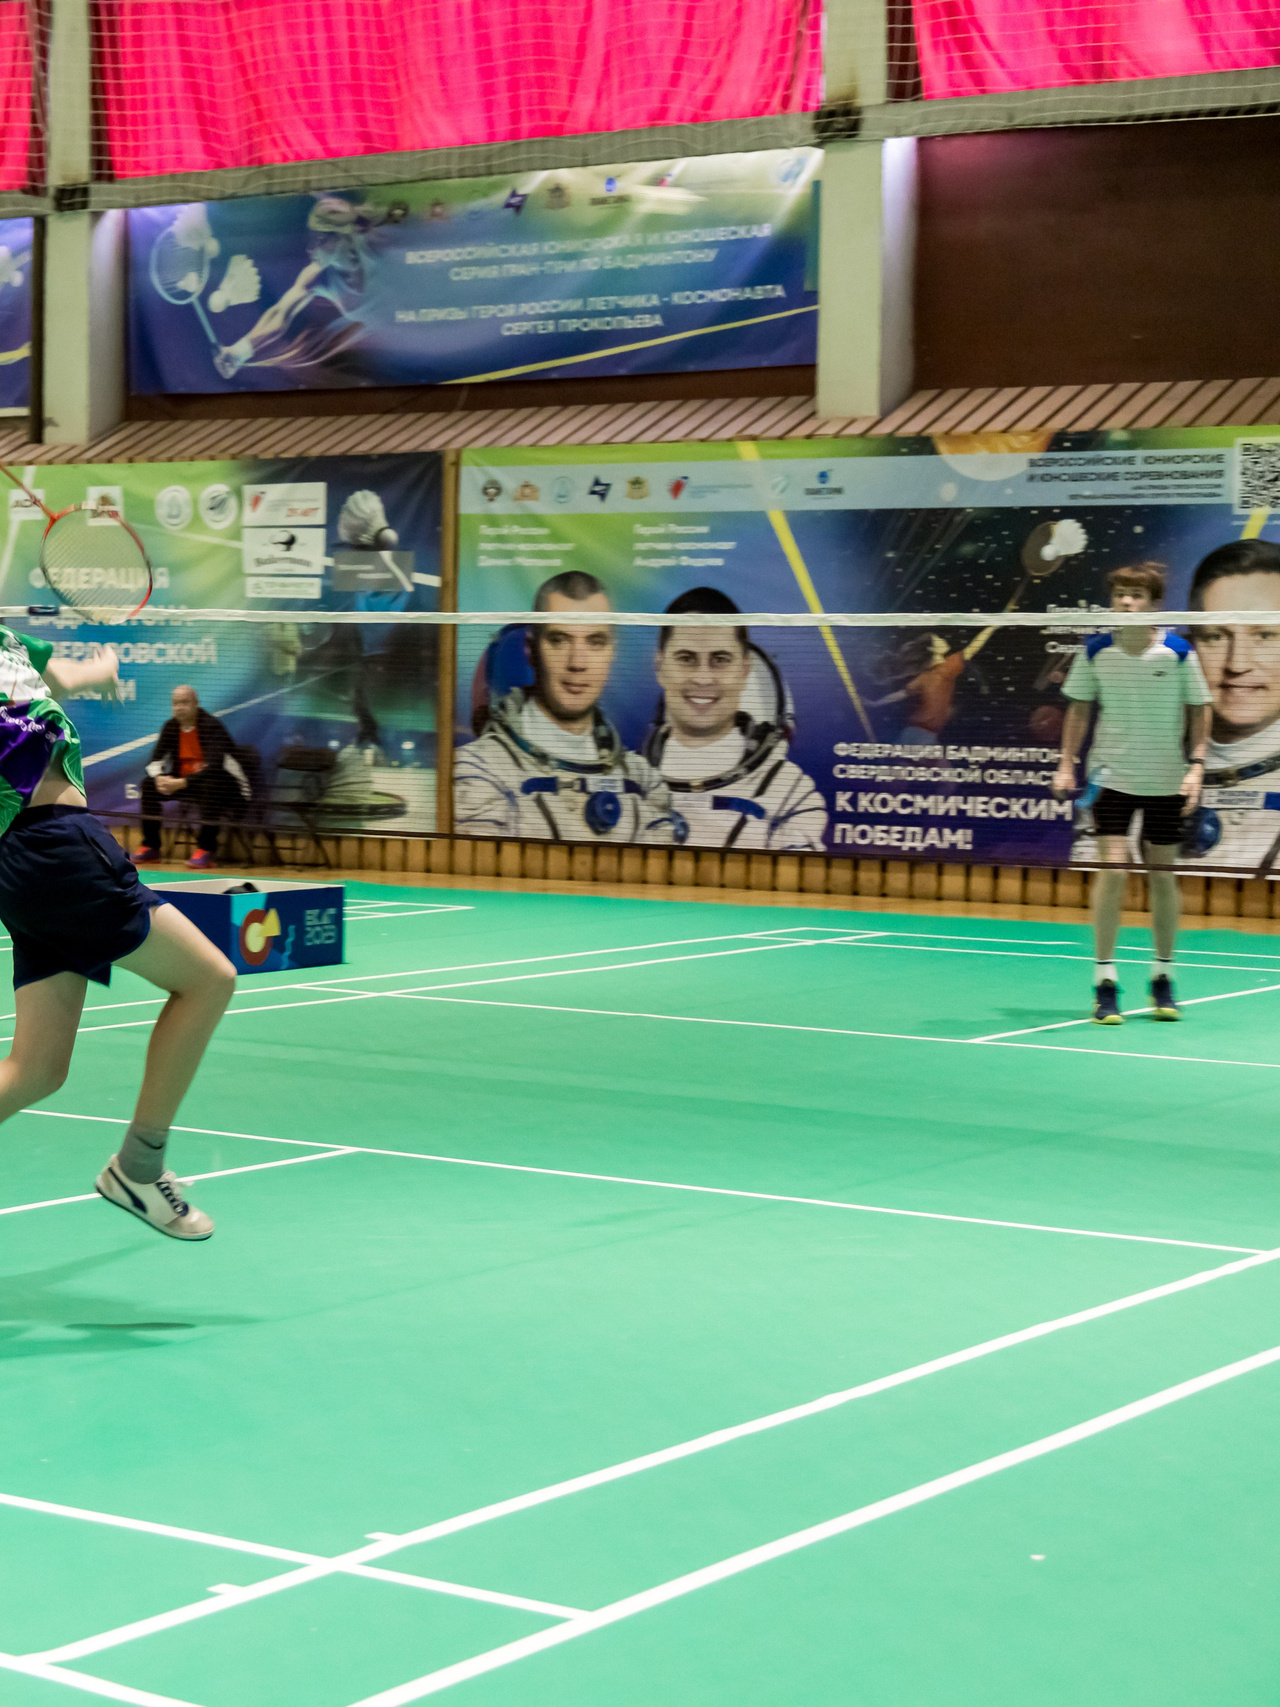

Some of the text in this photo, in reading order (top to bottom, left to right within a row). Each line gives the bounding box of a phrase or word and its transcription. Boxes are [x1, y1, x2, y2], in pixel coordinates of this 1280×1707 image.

[833, 742, 944, 761] ФЕДЕРАЦИЯ
[832, 763, 982, 783] СВЕРДЛОВСКОЙ
[835, 791, 1074, 821] К КОСМИЧЕСКИМ
[833, 823, 973, 851] ПОБЕДАМ!
